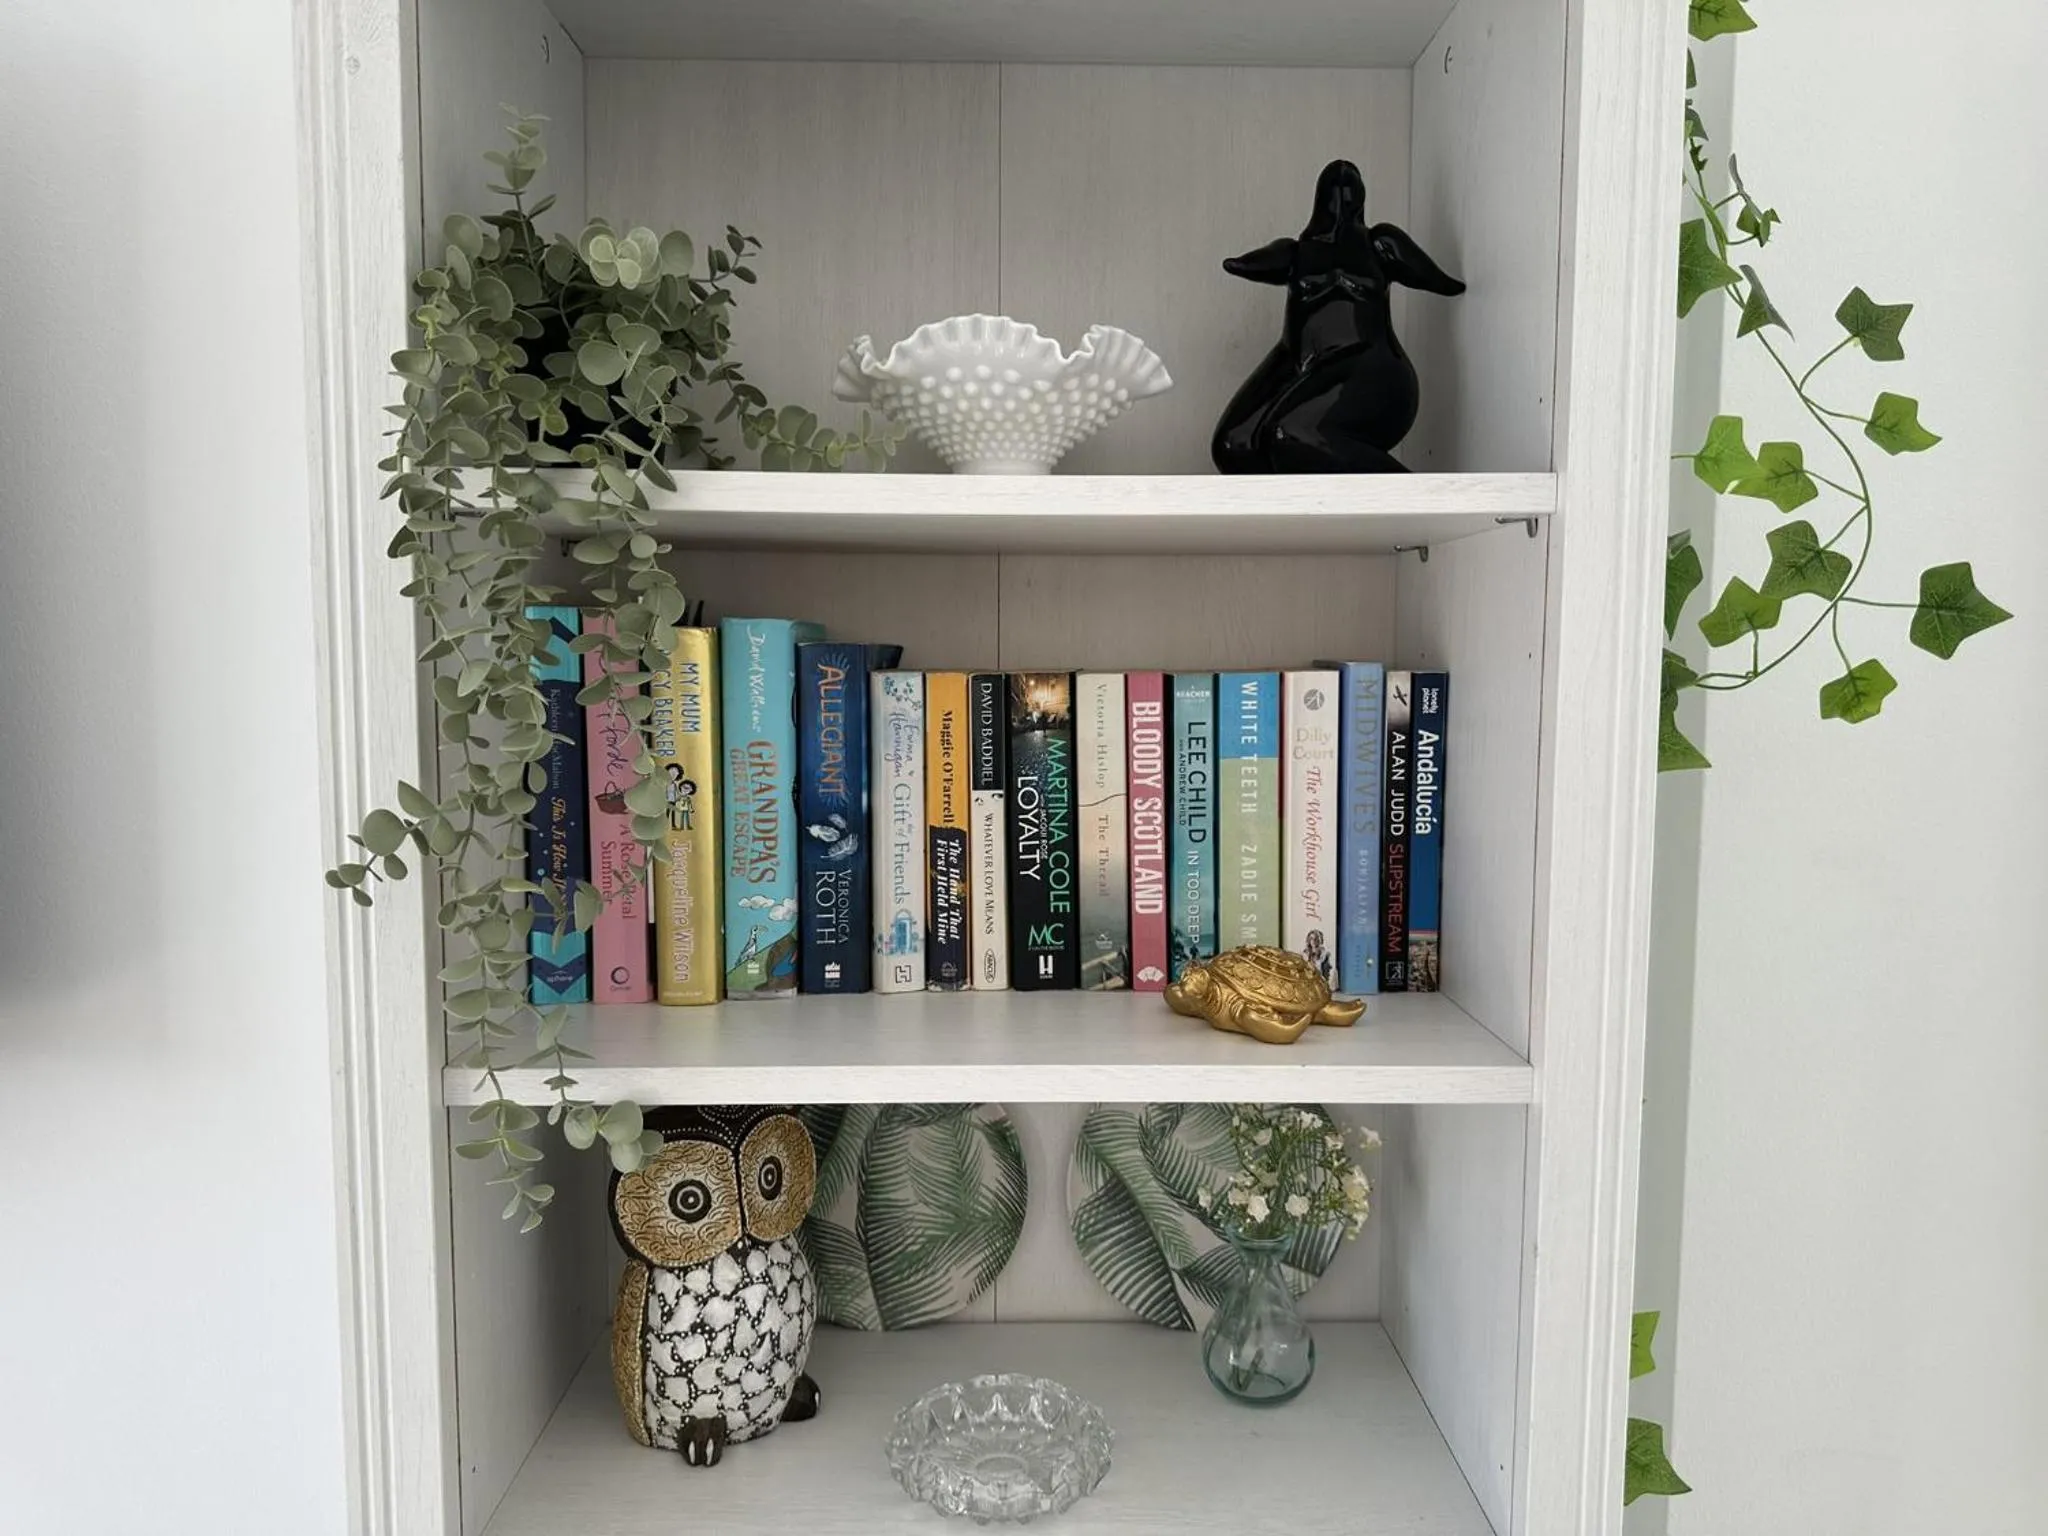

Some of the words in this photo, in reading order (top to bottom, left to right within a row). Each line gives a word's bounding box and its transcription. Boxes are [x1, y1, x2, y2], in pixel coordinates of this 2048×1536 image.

[680, 662, 700, 688] MY
[680, 693, 701, 734] MUM
[981, 682, 993, 726] DAVID
[1096, 684, 1108, 738] Victoria
[1240, 680, 1259, 745] WHITE
[1421, 687, 1430, 715] planet
[1430, 687, 1440, 715] lonely
[654, 698, 676, 758] BEAKER
[818, 664, 850, 798] ALLEGIANT
[884, 711, 909, 778] Hannigan
[904, 720, 919, 763] Emma
[940, 710, 954, 758] Maggie
[1132, 700, 1163, 789] BLOODY
[1187, 721, 1207, 766] LEE
[1296, 727, 1332, 746] Dilly
[730, 748, 750, 805] GREAT
[981, 728, 994, 787] BADDIEL
[1096, 744, 1109, 789] Hislop
[1179, 753, 1187, 795] ANDREW
[1292, 746, 1334, 761] Court
[1354, 679, 1378, 834] MIDWIVES
[1391, 731, 1406, 781] ALAN
[942, 762, 956, 824] O'Farrell
[1048, 737, 1070, 844] MARTINA
[1240, 753, 1258, 814] TEETH
[1306, 765, 1323, 795] The
[1415, 728, 1441, 835] Andalucía
[552, 797, 567, 822] This
[747, 740, 780, 884] GRANDPA'S
[893, 783, 911, 826] Gift
[1017, 775, 1041, 881] LOYALTY
[1098, 814, 1109, 841] The
[1179, 798, 1187, 827] CHILD
[1187, 770, 1207, 843] CHILD
[1390, 789, 1406, 837] JUDD
[619, 823, 632, 837] A
[731, 812, 750, 878] ESCAPE
[948, 839, 963, 864] The
[984, 813, 994, 869] WHATEVER
[1302, 798, 1323, 884] Workhouse
[601, 841, 618, 906] Summer
[621, 842, 635, 879] Rose
[894, 843, 912, 905] Friends
[936, 839, 949, 873] First
[1133, 796, 1164, 914] SCOTLAND
[1187, 849, 1201, 866] IN
[1240, 844, 1258, 902] ZADIE
[667, 839, 694, 925] Jacqueline
[937, 875, 949, 908] Held
[948, 867, 962, 907] Hand
[983, 871, 994, 897] LOVE
[1048, 851, 1070, 913] COLE
[1187, 871, 1200, 899] TOO
[1300, 888, 1322, 922] Girl
[1387, 843, 1405, 954] SLIPSTREAM
[815, 871, 836, 944] ROTH
[837, 870, 852, 944] VERONICA
[937, 911, 950, 945] Mine
[949, 909, 964, 941] That
[984, 900, 995, 935] MEANS
[1187, 904, 1200, 944] DEEP
[673, 929, 695, 984] Wilson
[1027, 922, 1065, 947] MC
